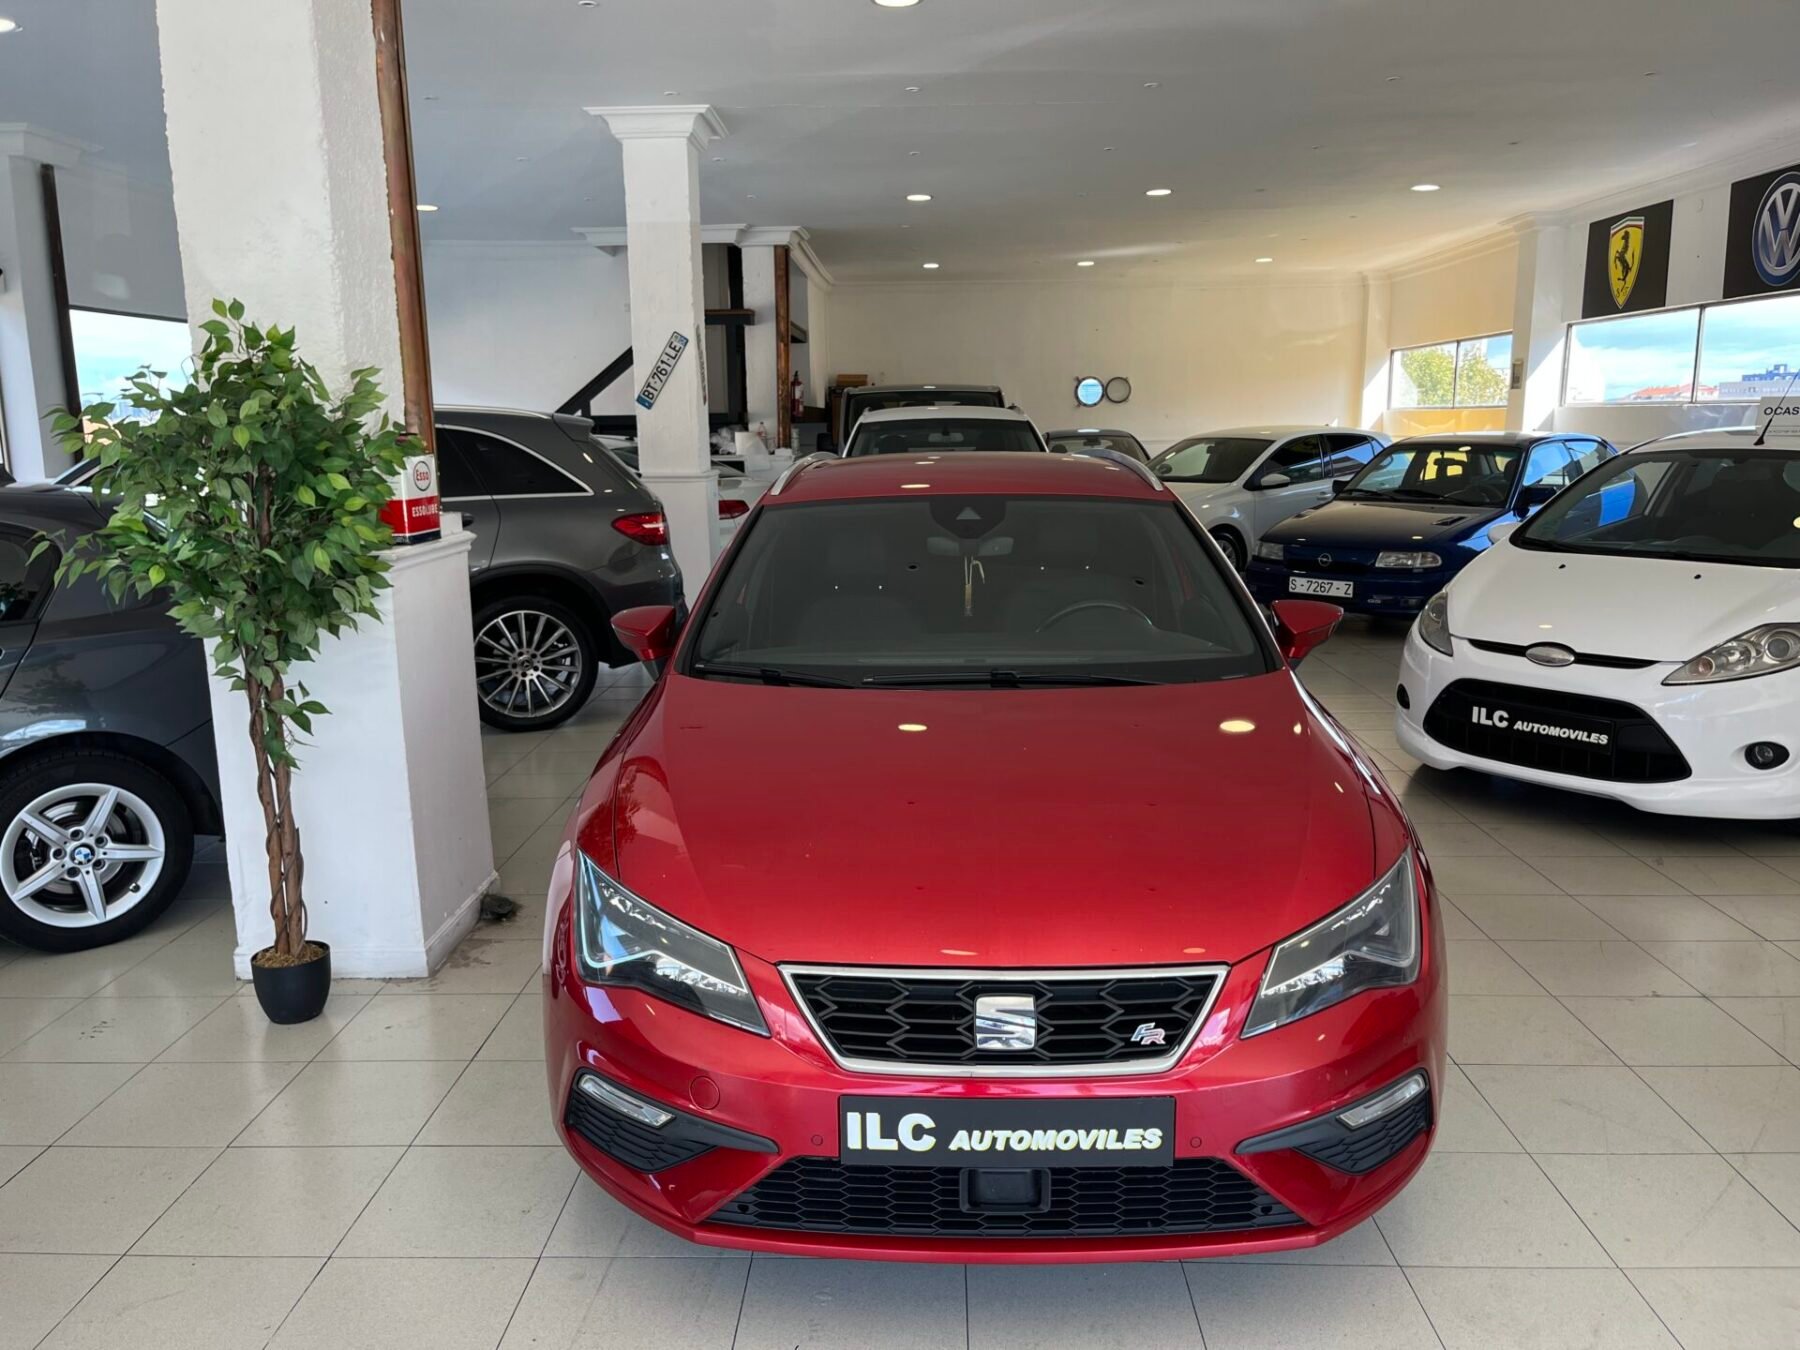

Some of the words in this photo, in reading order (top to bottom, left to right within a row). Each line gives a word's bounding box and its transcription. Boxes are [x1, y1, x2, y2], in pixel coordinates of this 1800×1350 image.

[1471, 706, 1509, 729] ILC
[1513, 720, 1609, 745] AUTOMOVILES
[1130, 1021, 1166, 1046] FR
[846, 1111, 937, 1152] ILC
[948, 1127, 1164, 1152] AUTOMOVILES
